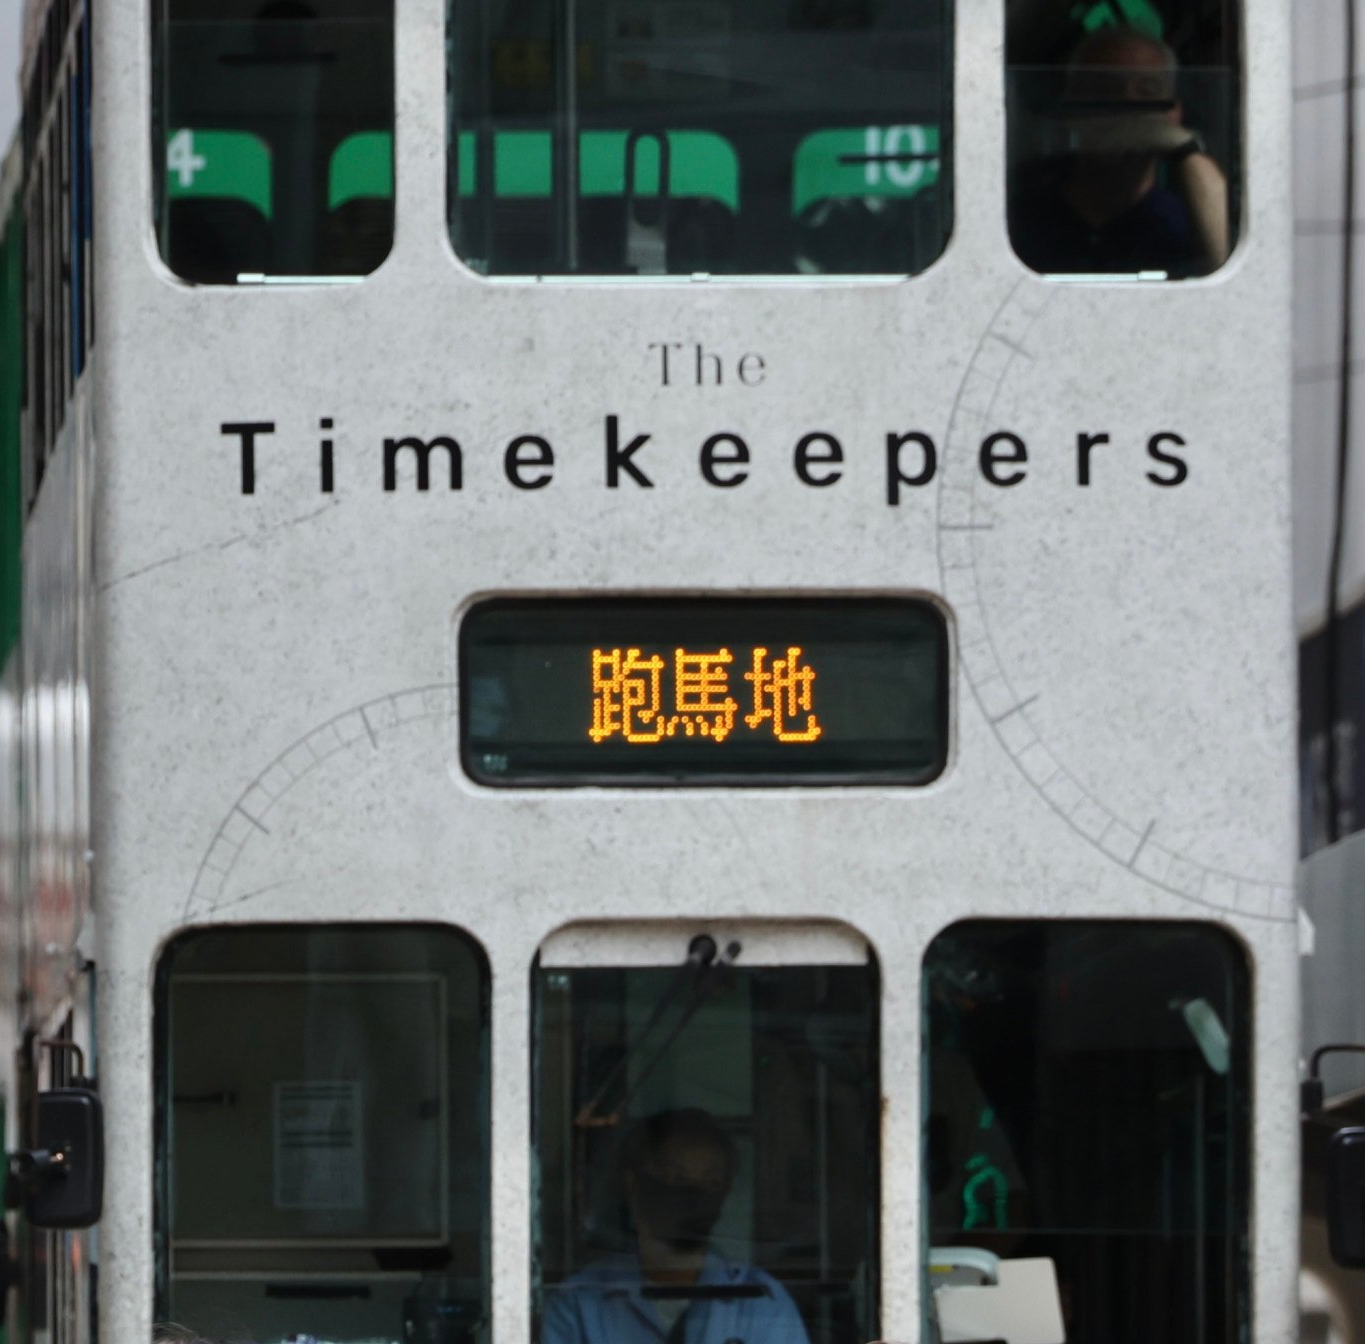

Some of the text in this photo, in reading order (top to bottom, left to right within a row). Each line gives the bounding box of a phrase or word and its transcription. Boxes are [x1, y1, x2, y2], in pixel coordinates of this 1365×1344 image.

[167, 128, 207, 187] 4
[648, 341, 768, 389] The
[220, 413, 1191, 507] Timekeepers
[589, 647, 822, 743] 跑馬地
